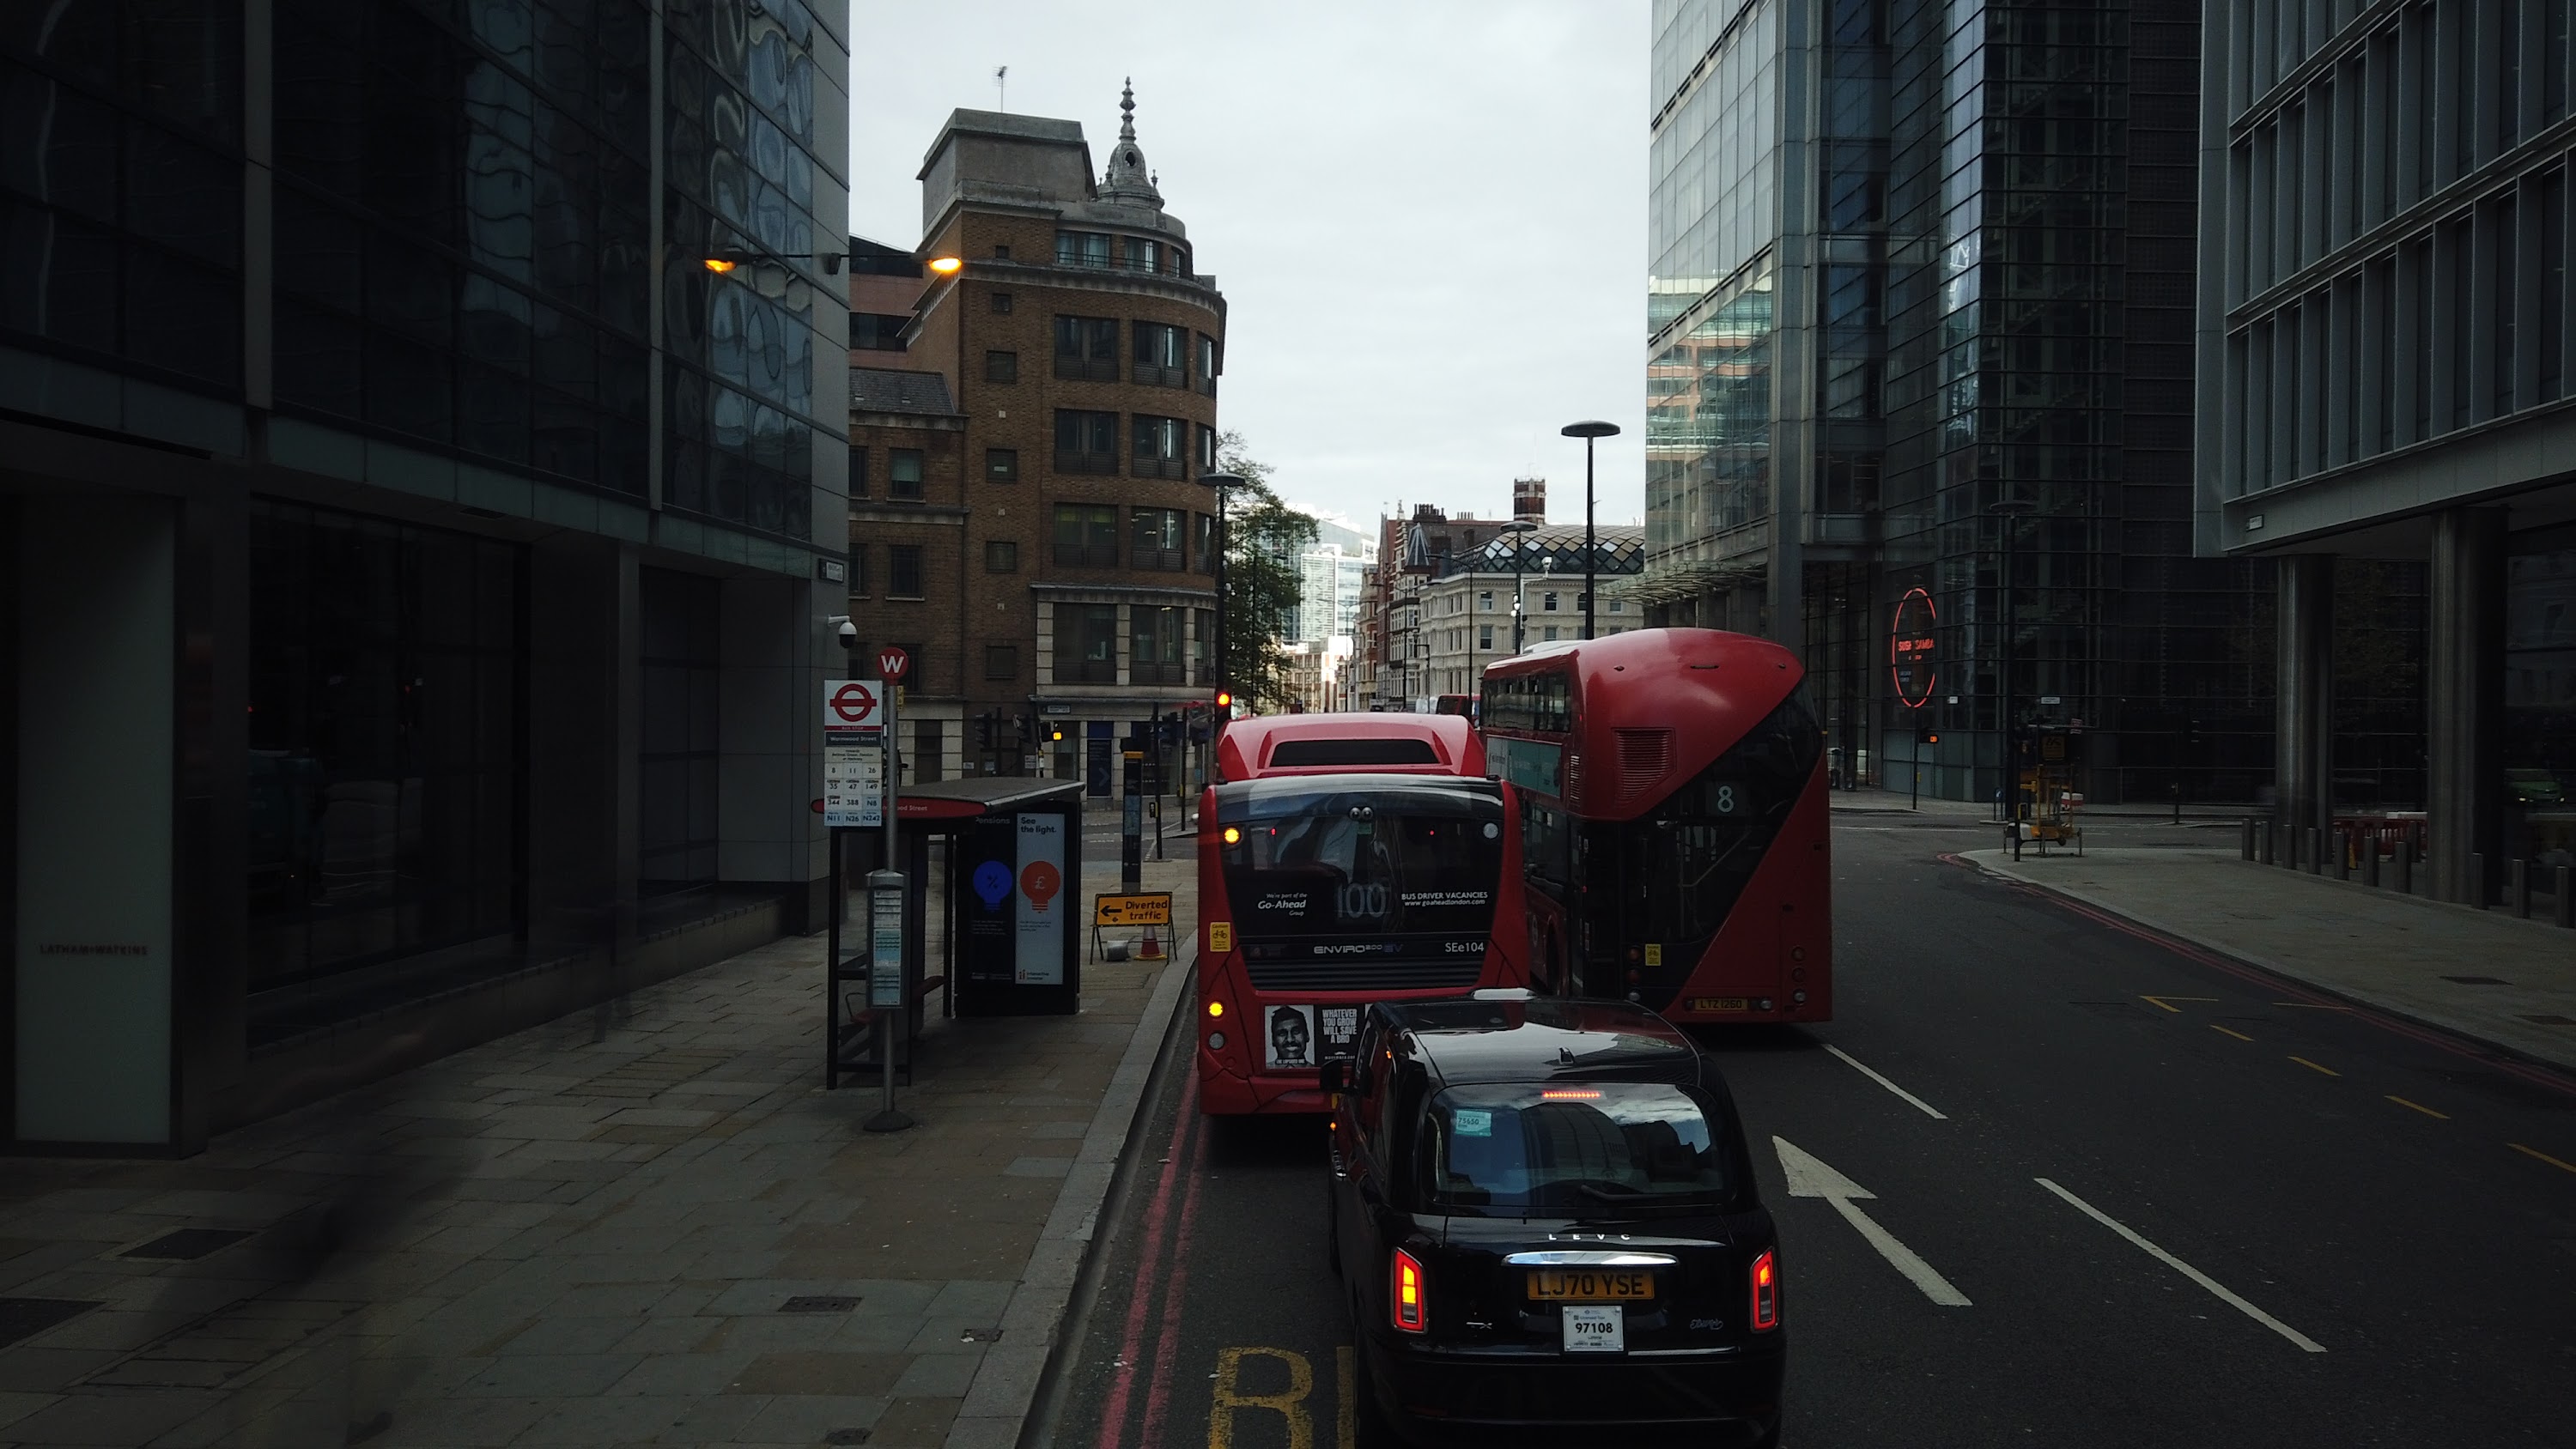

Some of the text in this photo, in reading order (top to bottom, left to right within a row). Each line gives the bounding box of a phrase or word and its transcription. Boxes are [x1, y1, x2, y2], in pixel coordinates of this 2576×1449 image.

[880, 655, 905, 674] W
[1717, 785, 1735, 813] 8
[1021, 816, 1036, 825] See
[1036, 825, 1057, 835] light.
[1125, 900, 1168, 910] Diverted
[1258, 900, 1307, 910] Go-Ahead
[1337, 882, 1387, 919] 100
[1130, 912, 1162, 920] traffic
[1444, 942, 1485, 953] SEe104
[1322, 1009, 1358, 1018] WHATEVER
[1337, 1017, 1357, 1026] GROW
[1323, 1026, 1358, 1035] WILL SAVE
[1330, 1035, 1351, 1044] A BRO
[1548, 1233, 1631, 1241] LEVC
[1537, 1274, 1644, 1295] LJ70 YSE
[1575, 1322, 1613, 1333] 97108
